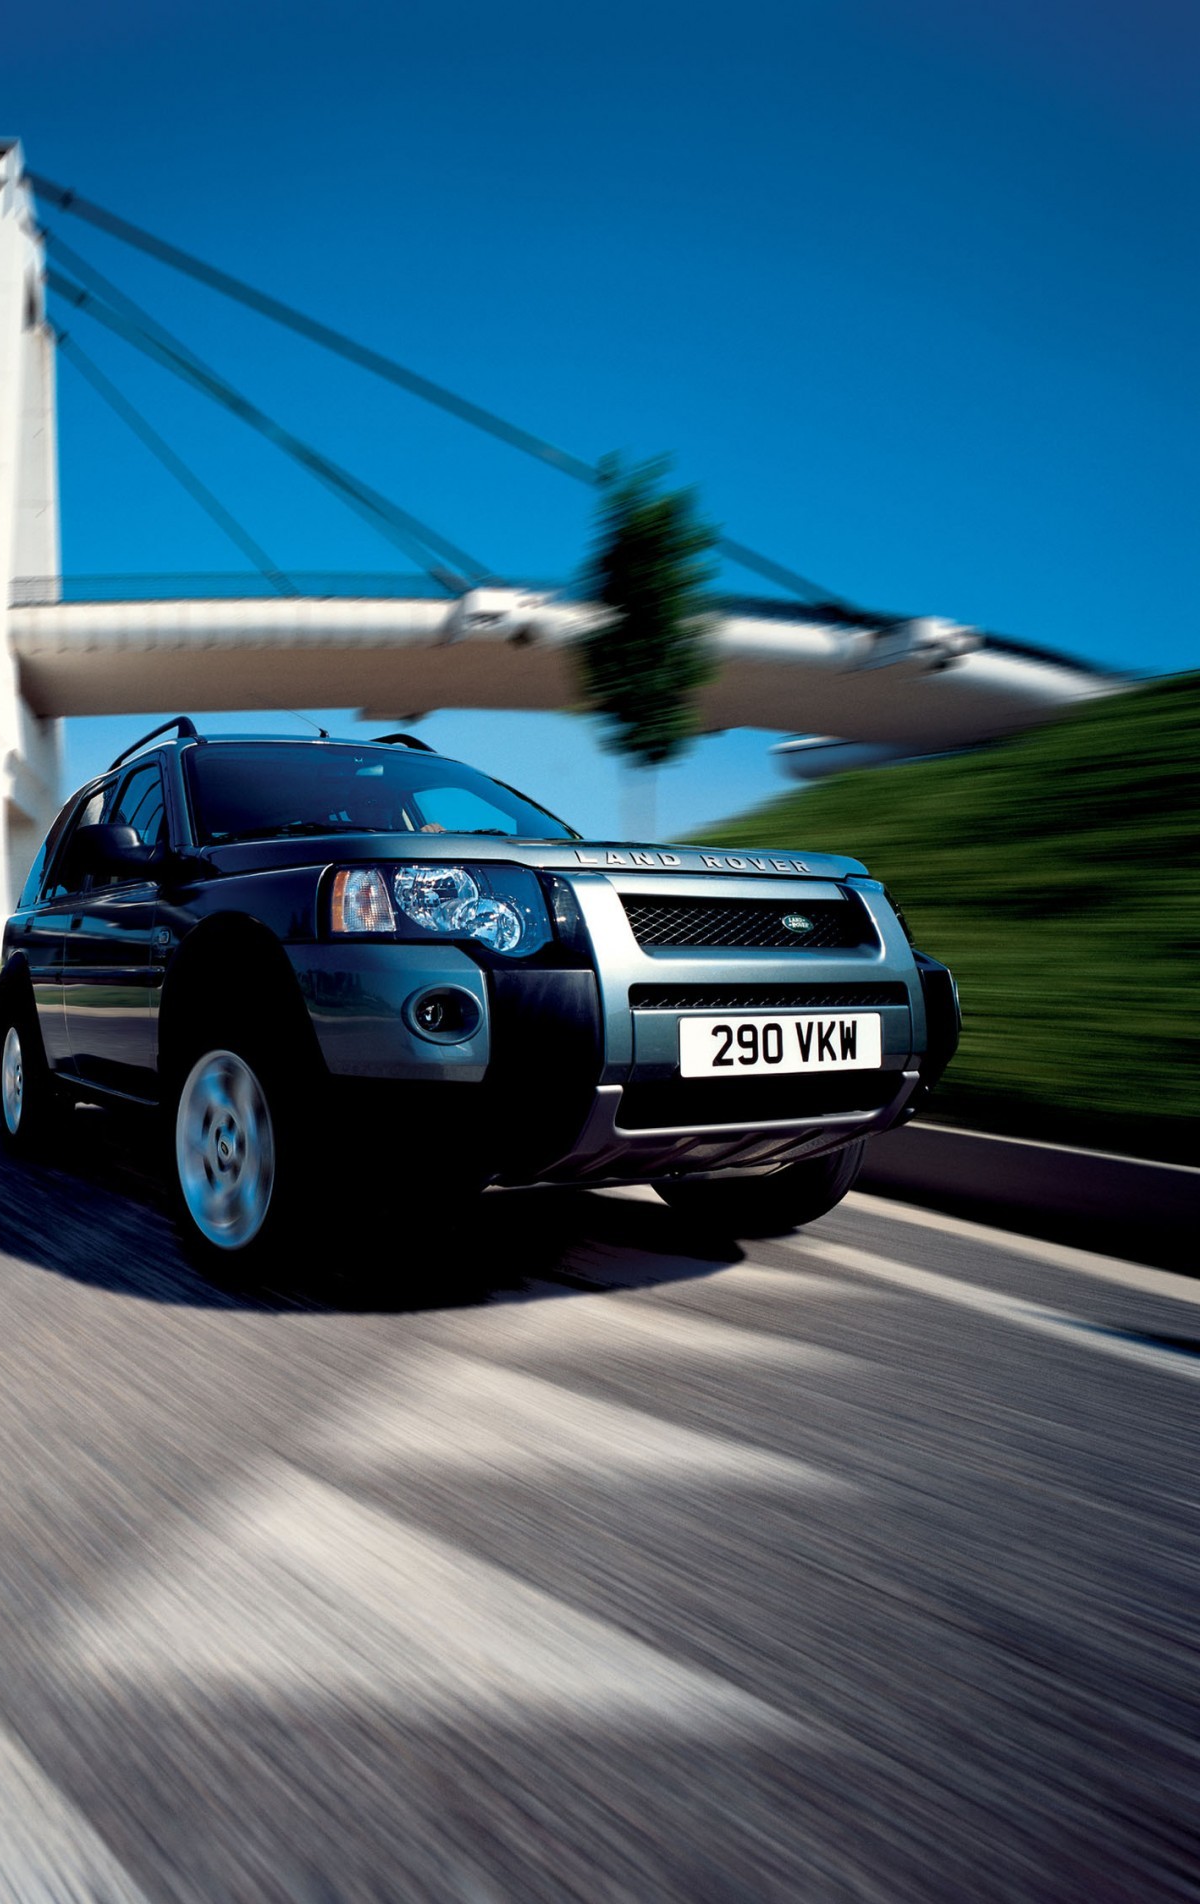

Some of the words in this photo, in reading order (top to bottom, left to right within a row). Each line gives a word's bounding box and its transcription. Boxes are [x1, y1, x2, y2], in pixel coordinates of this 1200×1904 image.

[574, 850, 681, 867] LAND
[700, 855, 811, 873] ROVER
[711, 1022, 783, 1067] 290
[795, 1020, 858, 1063] VKW
